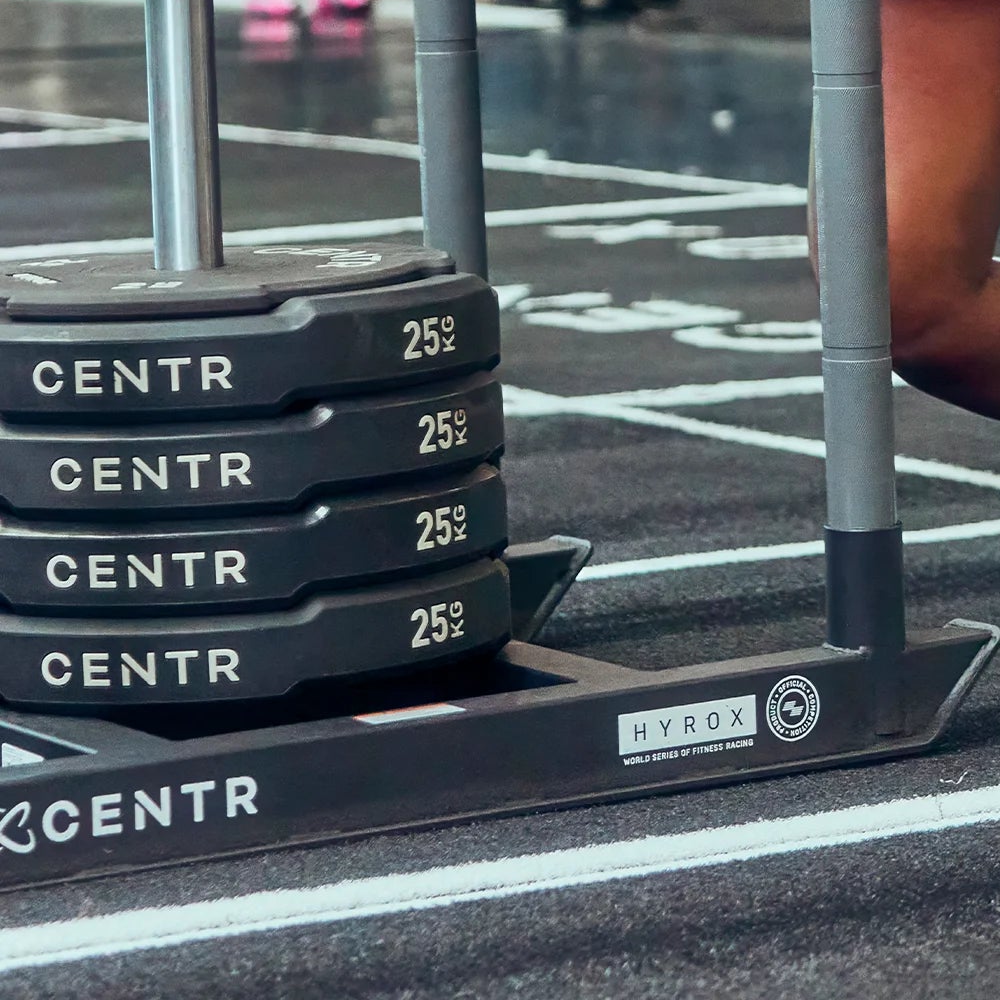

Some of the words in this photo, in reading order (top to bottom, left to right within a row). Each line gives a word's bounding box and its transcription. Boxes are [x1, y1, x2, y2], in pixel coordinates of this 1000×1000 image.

[403, 317, 440, 360] 25
[441, 315, 456, 353] KG
[32, 355, 234, 395] CENTR
[418, 410, 453, 454] 25
[454, 408, 468, 446] KG
[50, 451, 253, 493] CENTR
[416, 506, 452, 551] 25
[453, 504, 467, 542] KG
[45, 549, 248, 589] CENTR
[410, 603, 449, 648] 25
[449, 600, 464, 638] KG
[40, 647, 241, 687] CENTR
[777, 680, 808, 694] OFFICIAL
[634, 707, 744, 742] HYROX
[769, 698, 785, 734] PRODUCT
[790, 693, 816, 737] COMPETITION
[623, 755, 650, 766] WORLD
[651, 750, 679, 762] SERIES
[680, 748, 691, 757] OF
[692, 743, 724, 755] FITNESS
[725, 738, 754, 750] RACING
[41, 775, 260, 842] CENTR
